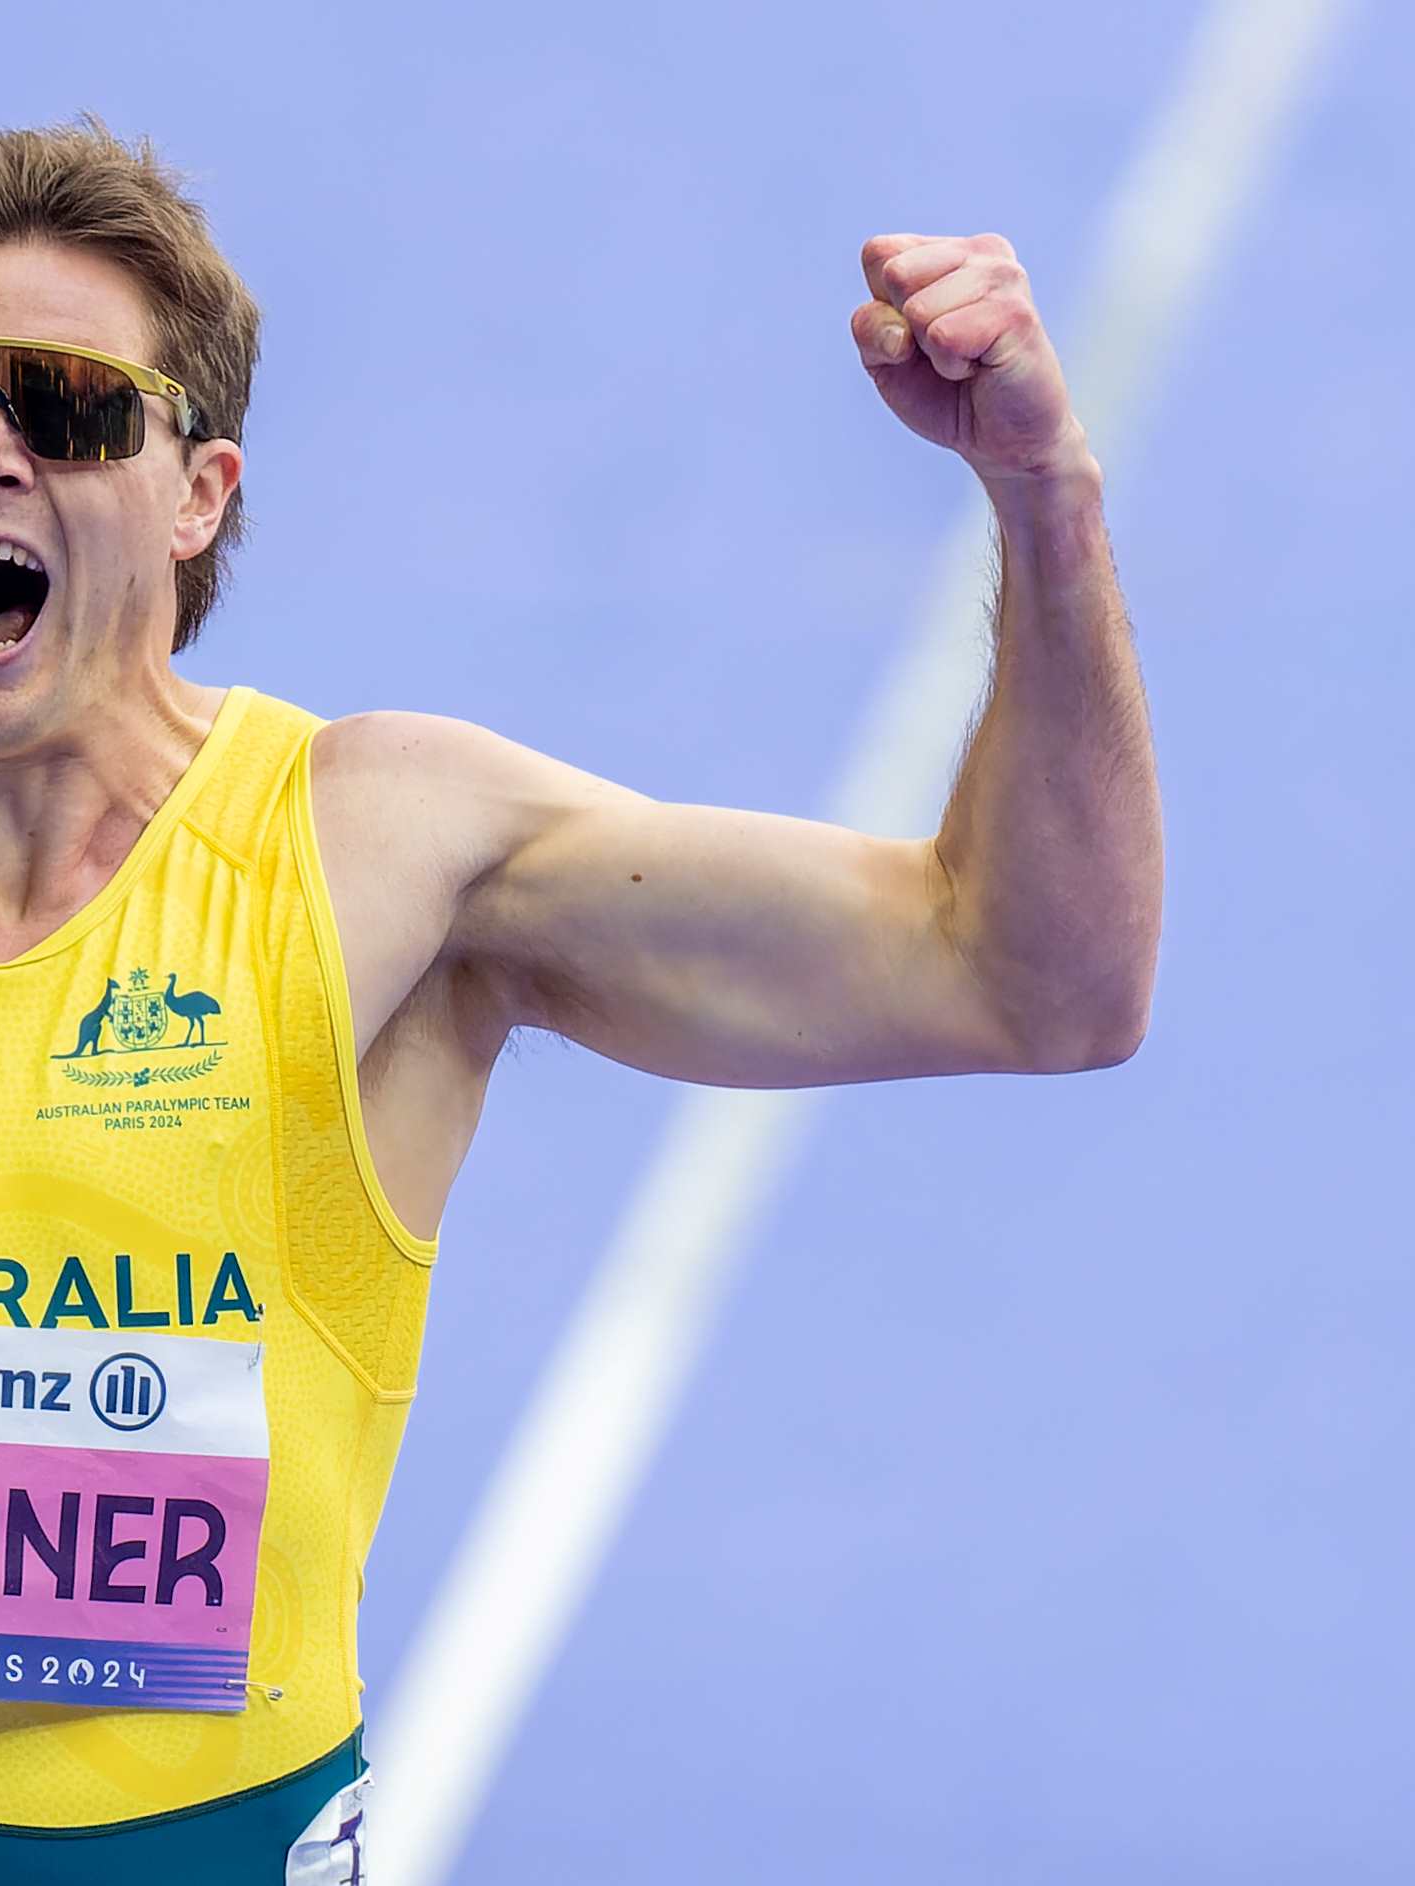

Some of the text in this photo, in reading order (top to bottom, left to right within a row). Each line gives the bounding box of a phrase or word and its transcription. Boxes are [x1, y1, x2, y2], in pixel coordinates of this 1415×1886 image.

[36, 1097, 250, 1120] AUSTRALIAN PARALYMPIC TEAM
[104, 1115, 183, 1130] PARIS 2024
[40, 1655, 146, 1689] 2024
